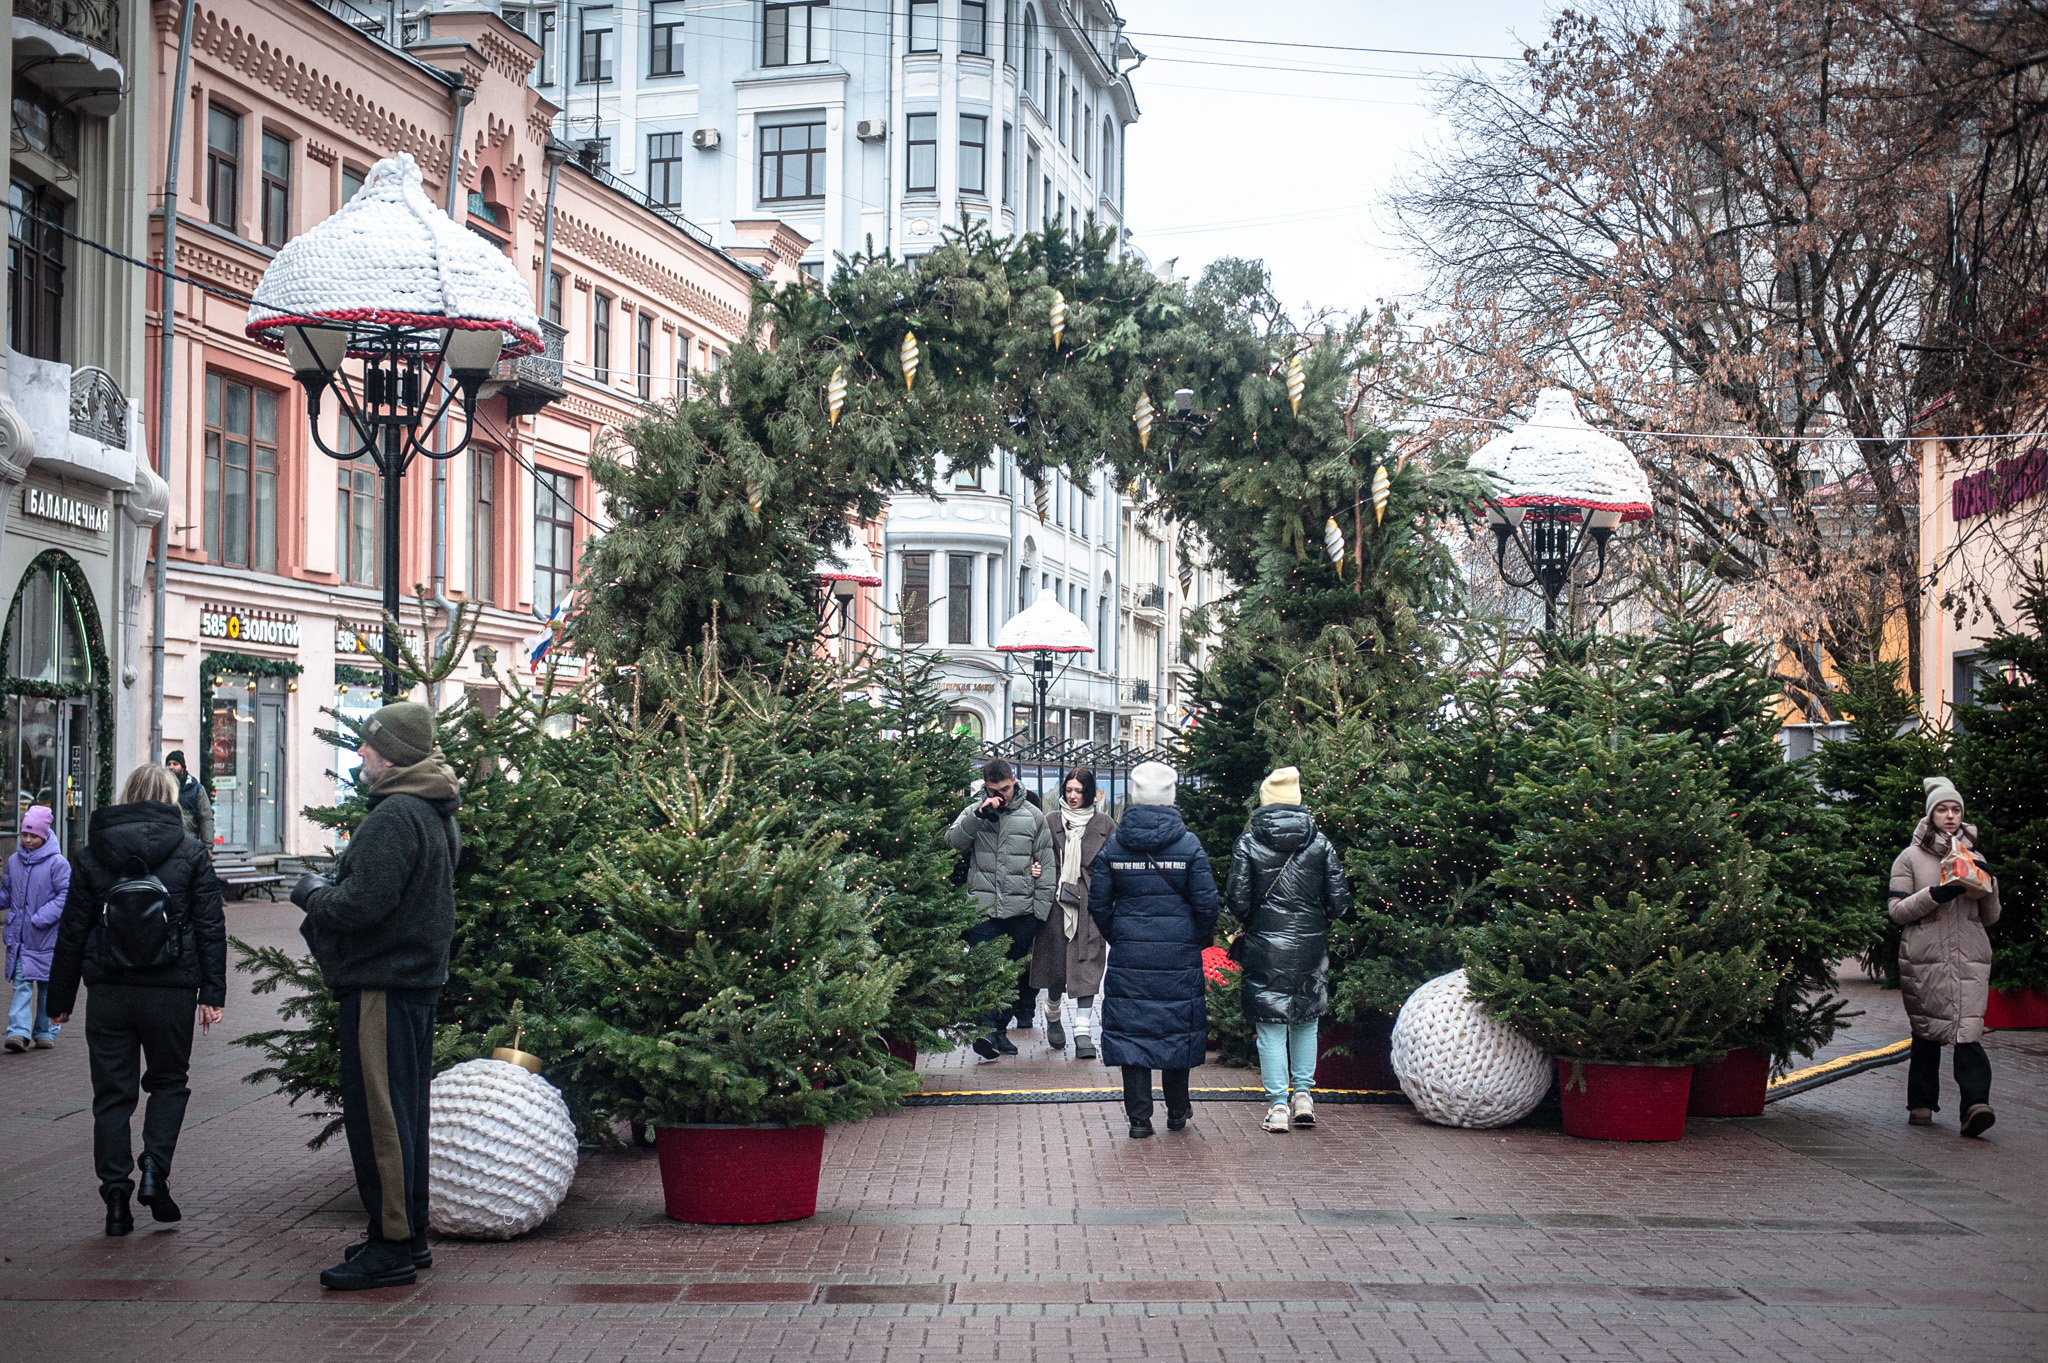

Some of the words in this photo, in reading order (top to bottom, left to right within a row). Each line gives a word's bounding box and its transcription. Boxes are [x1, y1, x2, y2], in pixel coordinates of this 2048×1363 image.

[30, 489, 109, 532] БАЛАЛАЕЧНАЯ
[203, 612, 228, 637] 585
[242, 617, 301, 647] ЗОЛОТОЙ
[337, 630, 357, 652] 585
[1124, 862, 1132, 870] THE
[1133, 862, 1145, 870] RULES
